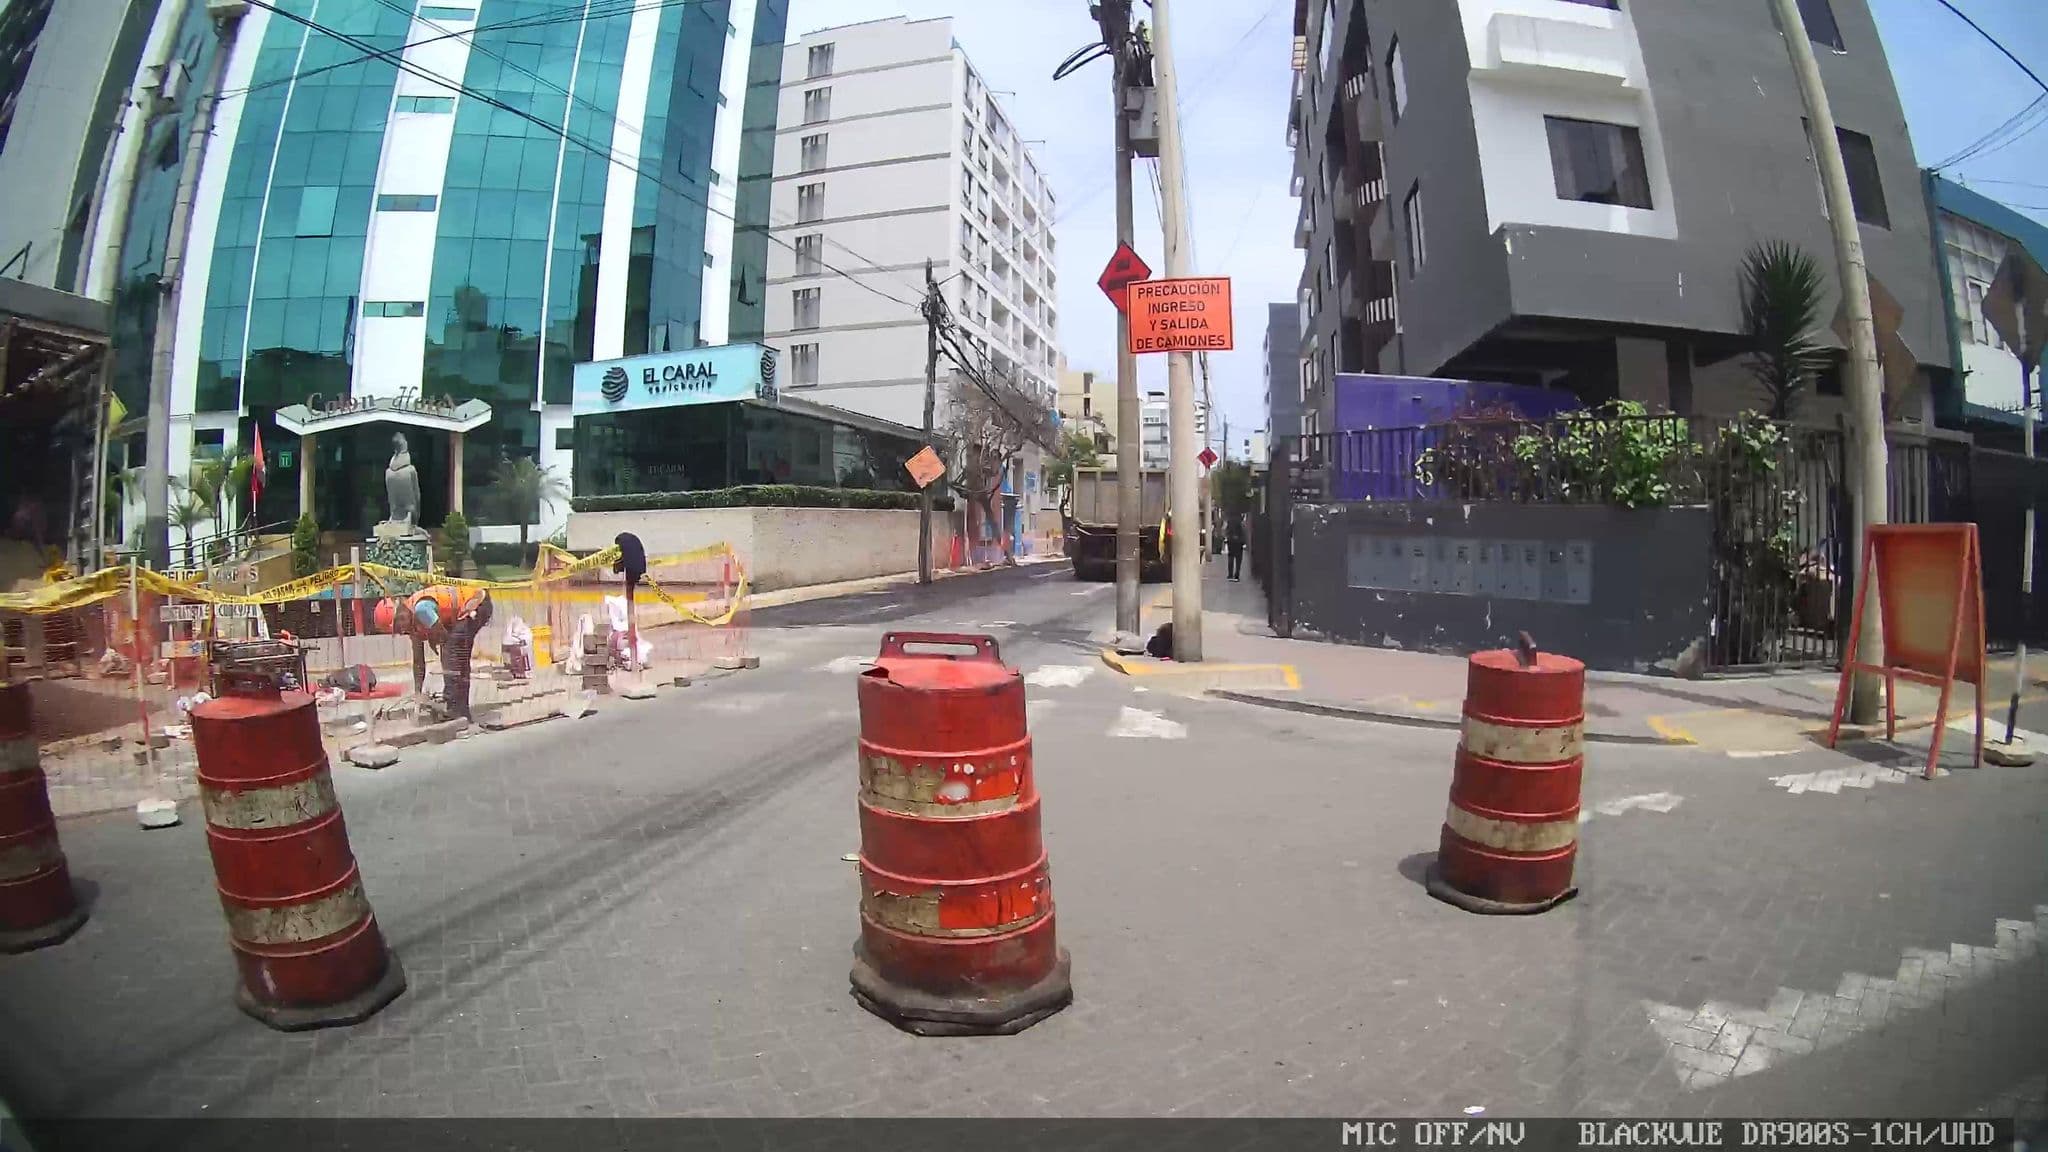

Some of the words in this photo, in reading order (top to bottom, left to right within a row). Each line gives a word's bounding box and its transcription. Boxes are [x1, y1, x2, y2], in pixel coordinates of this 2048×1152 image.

[1137, 281, 1220, 299] PRECAUCIÓN
[1148, 301, 1206, 314] INGRESO
[1149, 320, 1157, 331] Y
[1160, 317, 1209, 331] SALIDA
[1136, 338, 1153, 350] DE
[1156, 335, 1226, 349] CAMIONES
[643, 367, 660, 385] EL
[662, 361, 718, 383] CARAL
